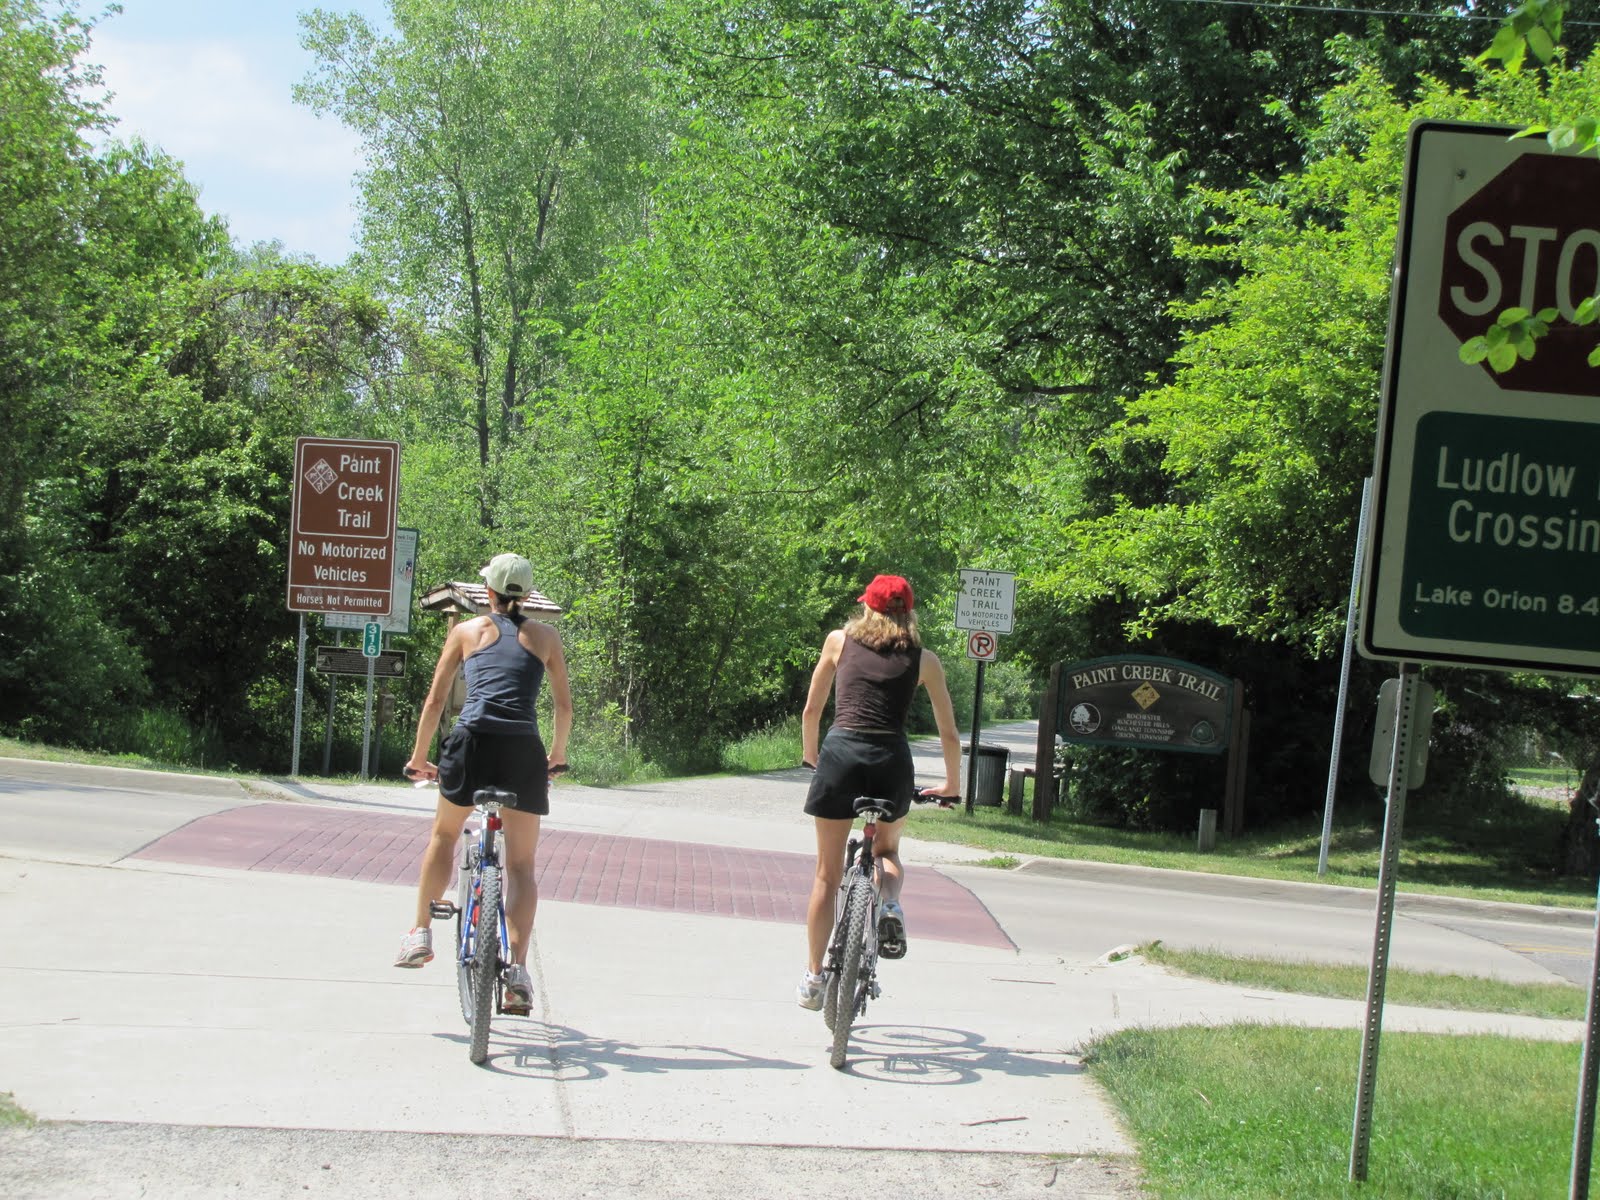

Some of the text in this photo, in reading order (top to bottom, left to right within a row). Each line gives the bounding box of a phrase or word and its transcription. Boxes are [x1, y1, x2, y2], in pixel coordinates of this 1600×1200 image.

[340, 454, 381, 474] Paint
[1437, 446, 1576, 498] Ludlow
[338, 482, 384, 502] Creek
[337, 509, 371, 528] Trail
[1449, 499, 1600, 553] Crossin
[298, 540, 315, 556] No
[322, 542, 387, 560] Motorized
[314, 565, 367, 583] Vehicles
[973, 577, 1000, 586] PAINT
[296, 593, 382, 608] Horses Not Permitted
[970, 588, 1002, 598] CREEK
[1415, 583, 1600, 616] Lake Orion 8.4
[972, 600, 1000, 610] TRAIL
[968, 619, 999, 627] VEHICLES
[972, 611, 1008, 620] MOTORIZED
[1072, 664, 1222, 701] PAINT CREEK TRAIL
[1139, 733, 1170, 741] TOWNSHIP
[1143, 727, 1175, 735] TOWNSHIP
